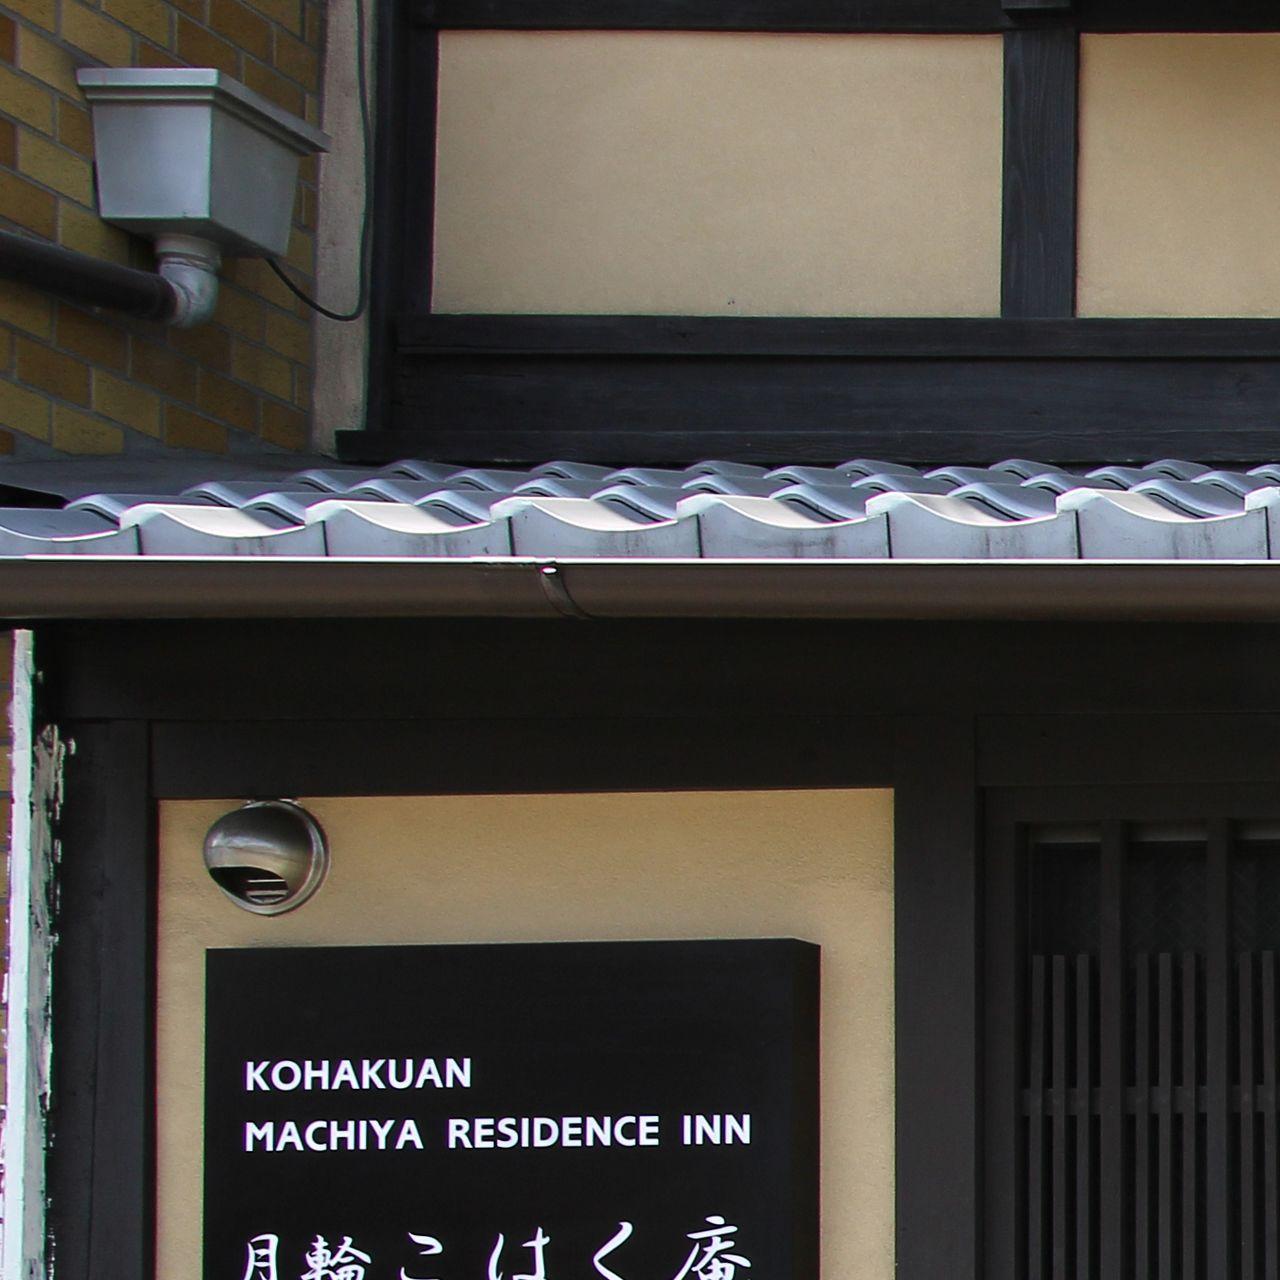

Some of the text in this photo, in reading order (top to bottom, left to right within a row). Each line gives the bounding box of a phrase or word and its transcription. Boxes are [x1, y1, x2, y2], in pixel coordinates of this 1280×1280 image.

[244, 1057, 472, 1092] KOHAKUAN
[244, 1113, 752, 1152] MACHIYA RESIDENCE INN
